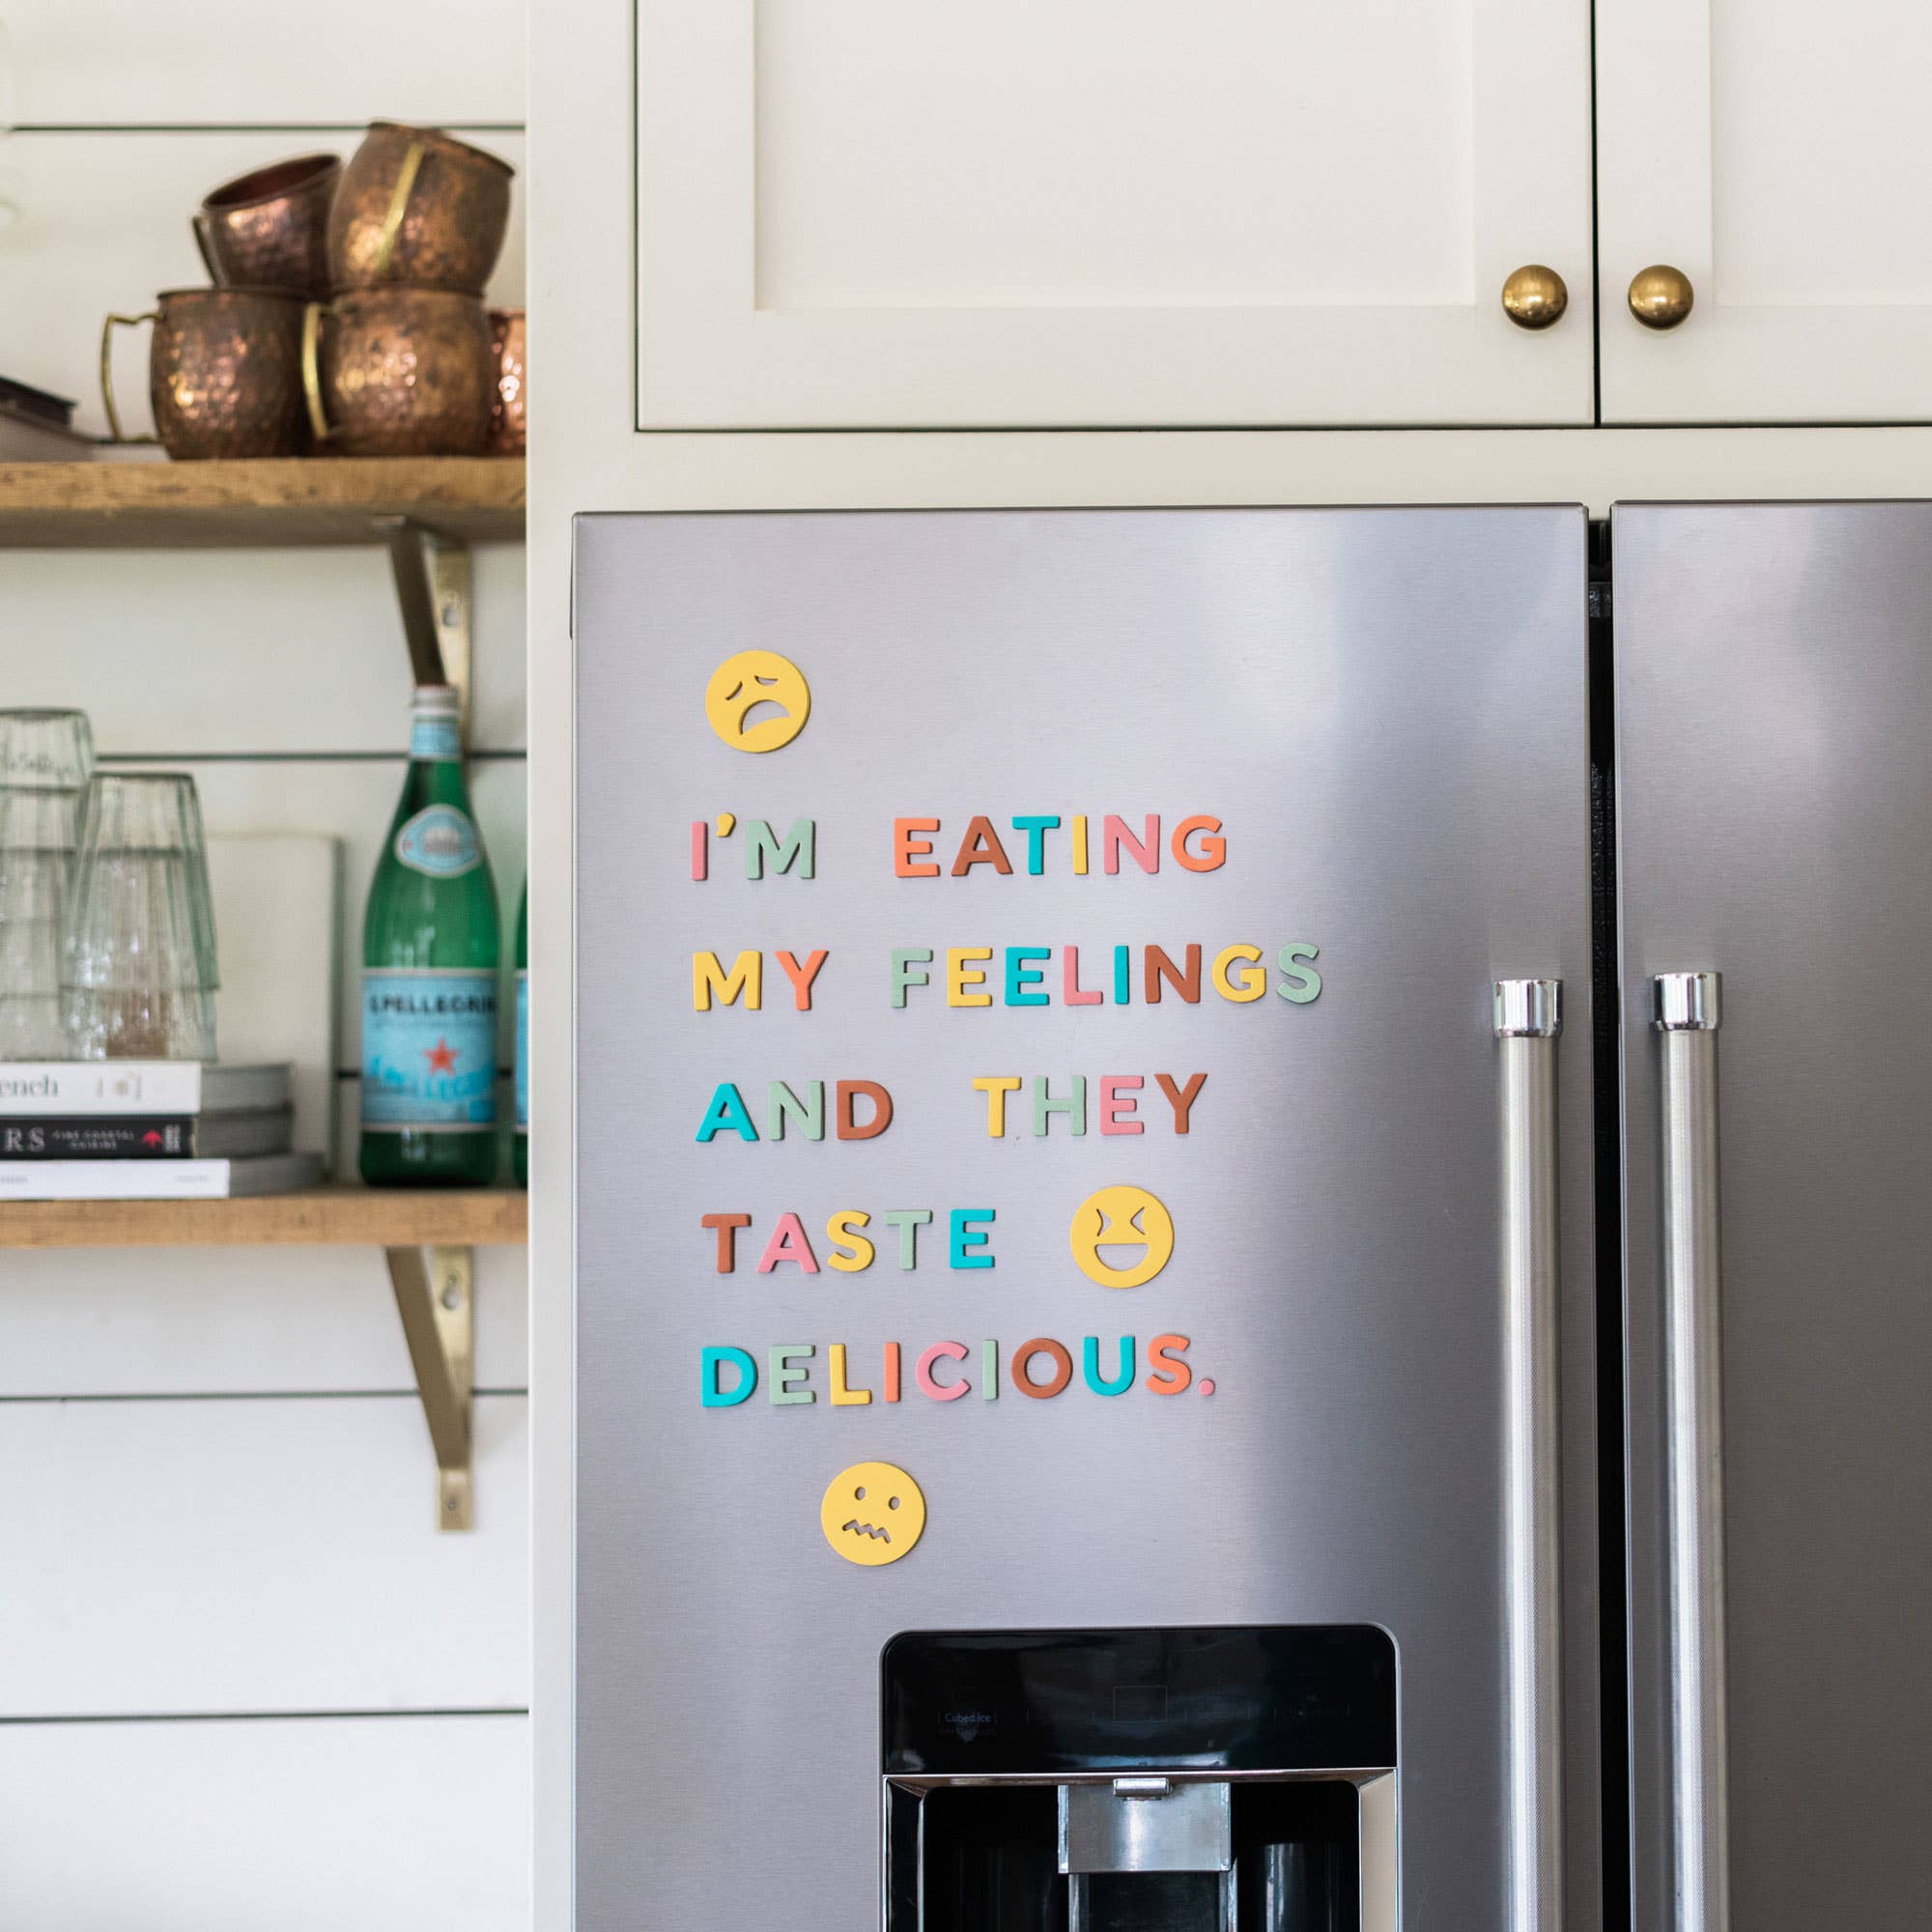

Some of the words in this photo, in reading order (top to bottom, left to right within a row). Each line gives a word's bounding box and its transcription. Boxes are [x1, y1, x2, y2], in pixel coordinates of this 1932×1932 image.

[691, 812, 815, 881] I'M
[894, 813, 1227, 879] EATING
[692, 949, 831, 1011] MY
[891, 943, 1321, 1009] FEELINGS
[695, 1079, 895, 1142] AND
[971, 1072, 1208, 1137] THEY
[700, 1208, 997, 1274] TASTE
[700, 1334, 1216, 1408] DELICIOUS.
[944, 1712, 975, 1723] Cubed
[977, 1713, 991, 1723] Ice
